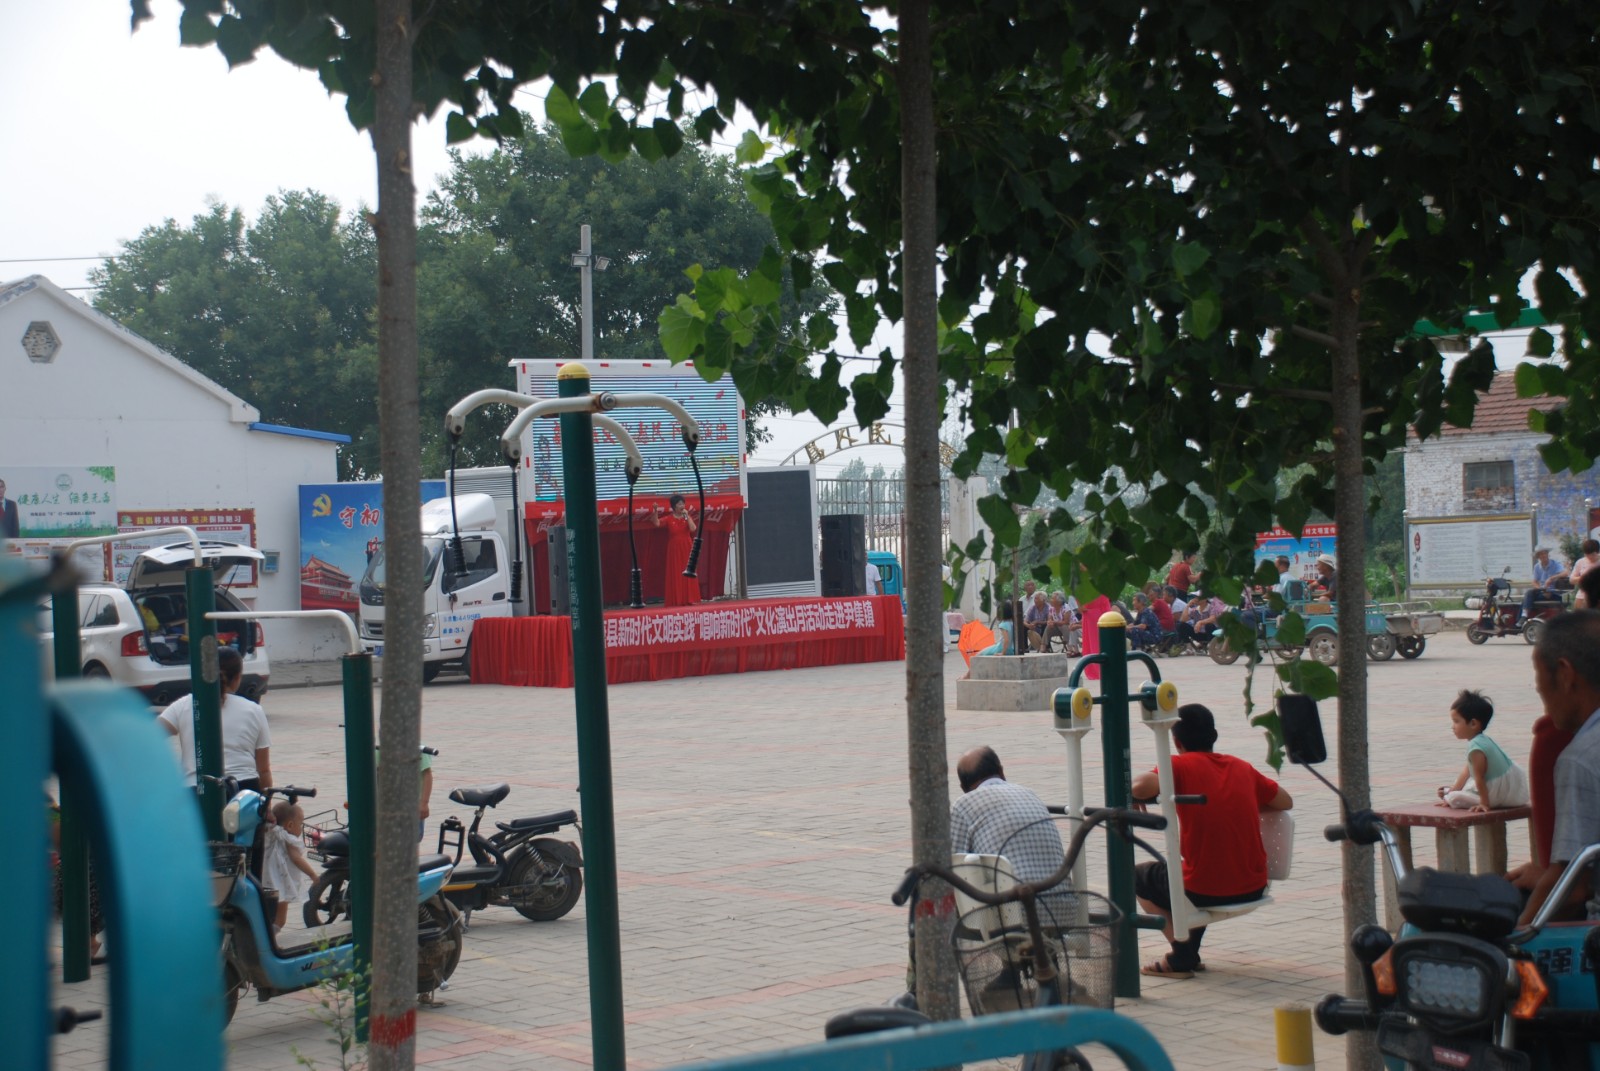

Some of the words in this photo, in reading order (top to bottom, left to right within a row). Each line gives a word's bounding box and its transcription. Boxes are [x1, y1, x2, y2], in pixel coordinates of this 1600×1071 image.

[17, 492, 61, 506] 健康人生
[338, 502, 384, 529] 守初
[603, 599, 875, 648] 县新时代文明实践“唱响新时代”文化演出月活动走进尹集镇
